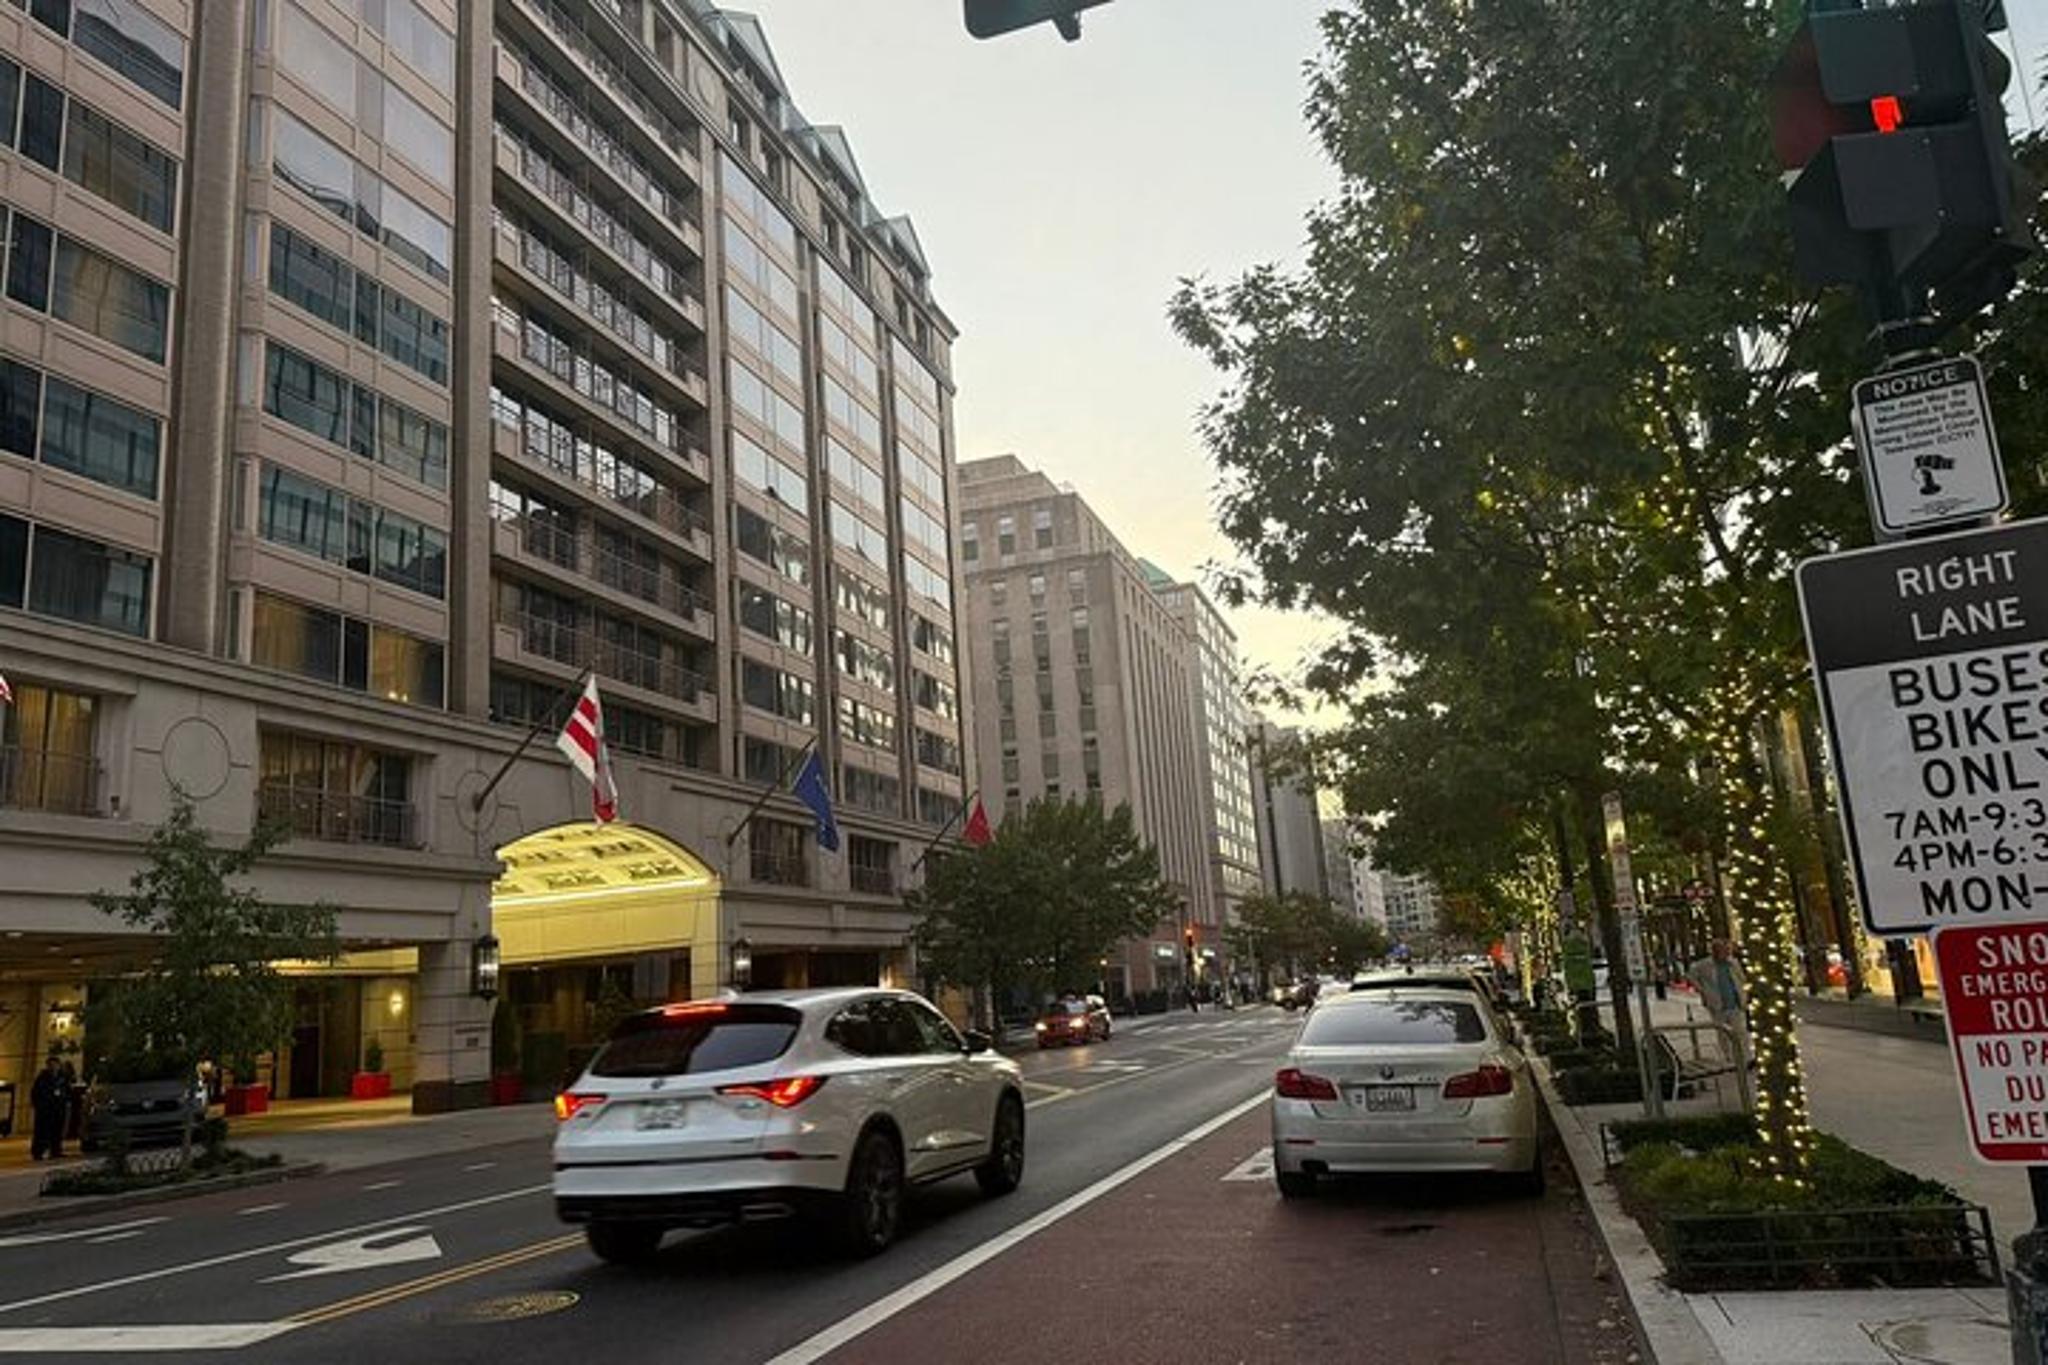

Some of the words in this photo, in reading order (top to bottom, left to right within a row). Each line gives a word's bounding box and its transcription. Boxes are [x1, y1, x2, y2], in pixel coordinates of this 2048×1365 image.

[1873, 366, 1960, 399] NOTICE
[1896, 550, 2017, 599] RIGHT
[1911, 597, 2026, 642] LANE
[1920, 873, 2048, 917] MON-
[1961, 971, 2046, 997] EMERG
[1976, 1041, 2012, 1068] NO
[1987, 1111, 2048, 1139] EME
